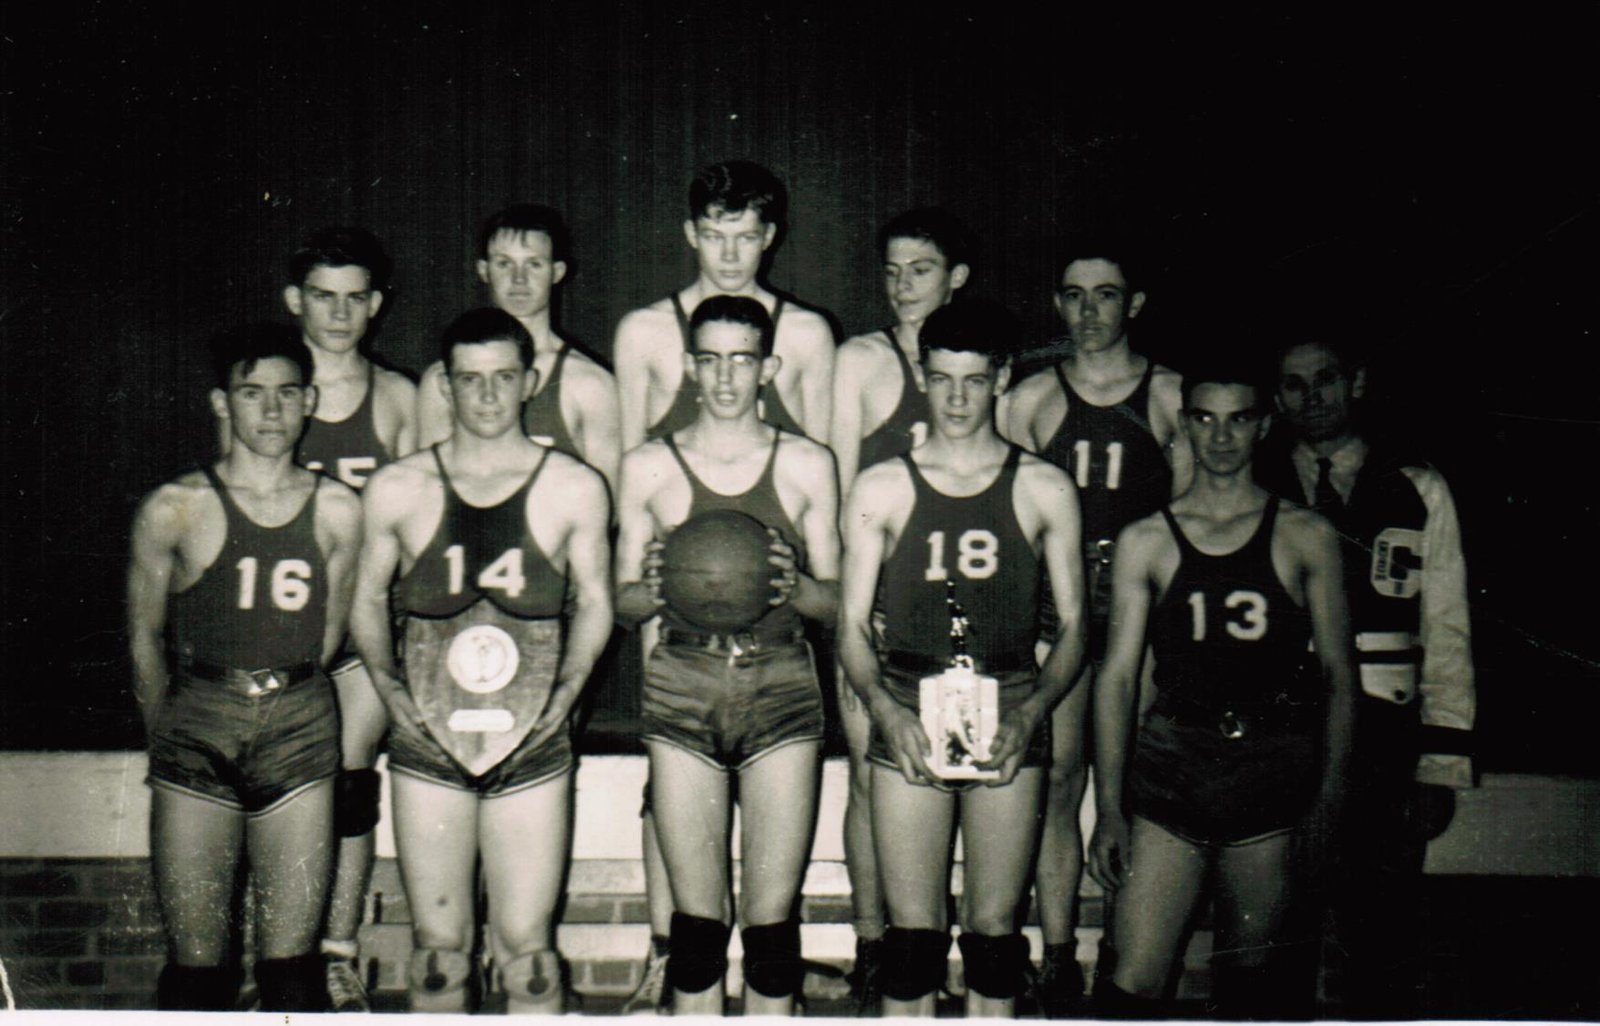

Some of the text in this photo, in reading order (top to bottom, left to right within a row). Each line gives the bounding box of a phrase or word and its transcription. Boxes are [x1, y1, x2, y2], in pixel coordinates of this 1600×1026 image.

[305, 456, 377, 489] 5
[1075, 440, 1123, 489] 11
[444, 544, 526, 598] 14
[925, 529, 998, 582] 18
[236, 556, 312, 612] 16
[1189, 592, 1268, 641] 13
